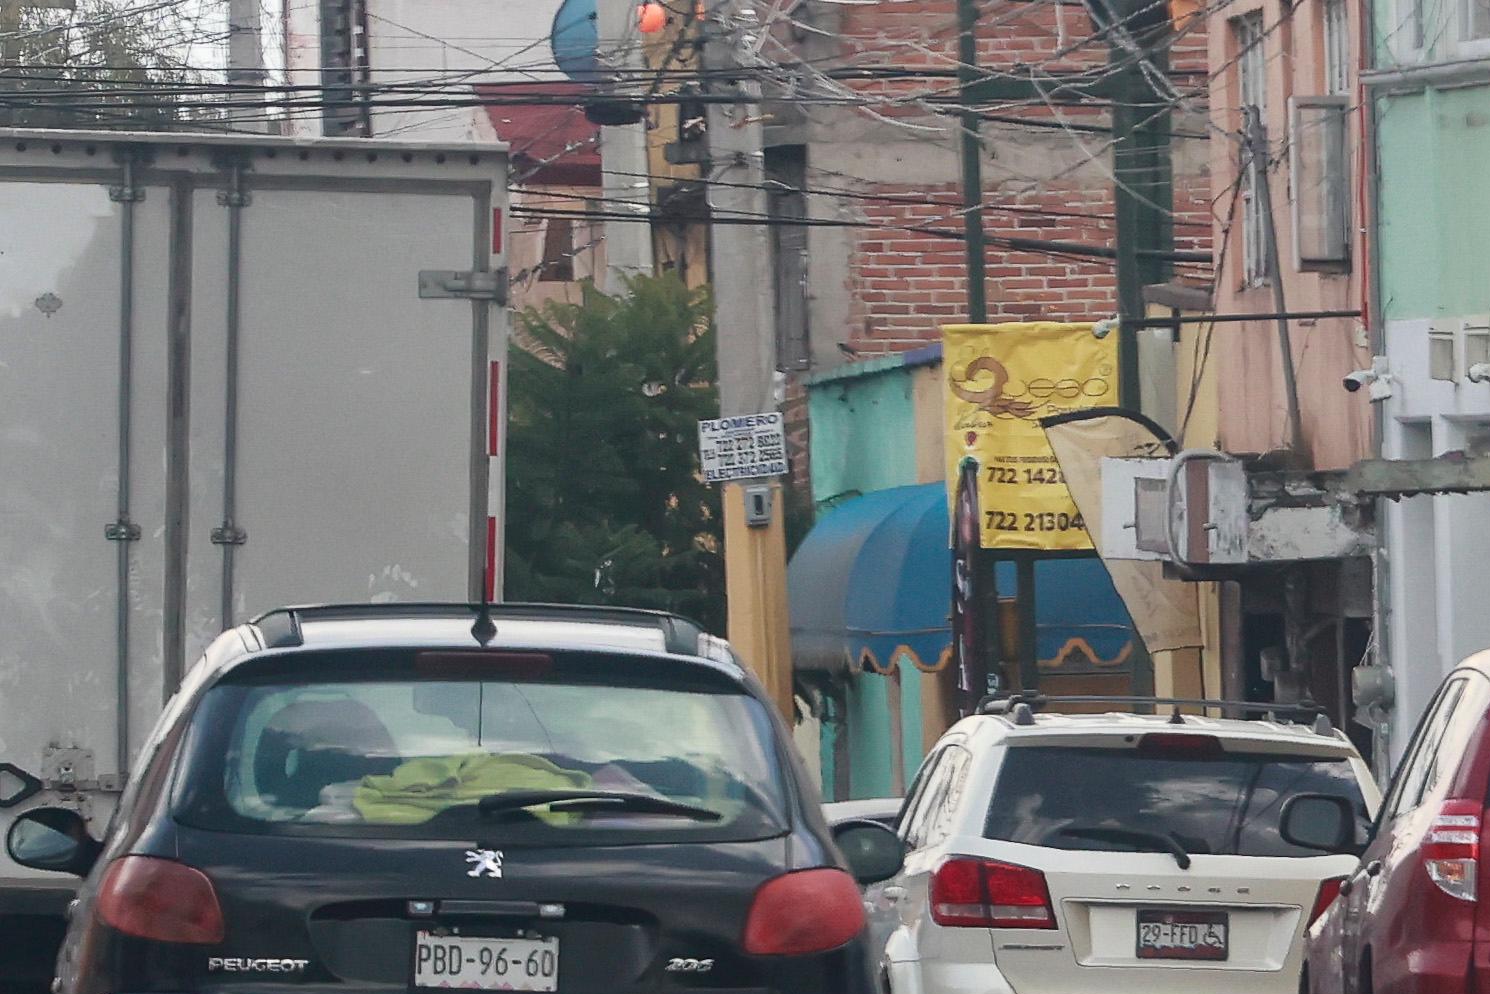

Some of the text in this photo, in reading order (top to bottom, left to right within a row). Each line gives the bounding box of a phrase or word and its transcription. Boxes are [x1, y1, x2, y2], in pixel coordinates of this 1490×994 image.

[701, 414, 777, 433] PLOMERO
[987, 467, 1017, 484] 722
[985, 511, 1018, 531] 722
[208, 957, 309, 972] PEUGEOT
[416, 943, 555, 977] PBD-96-60
